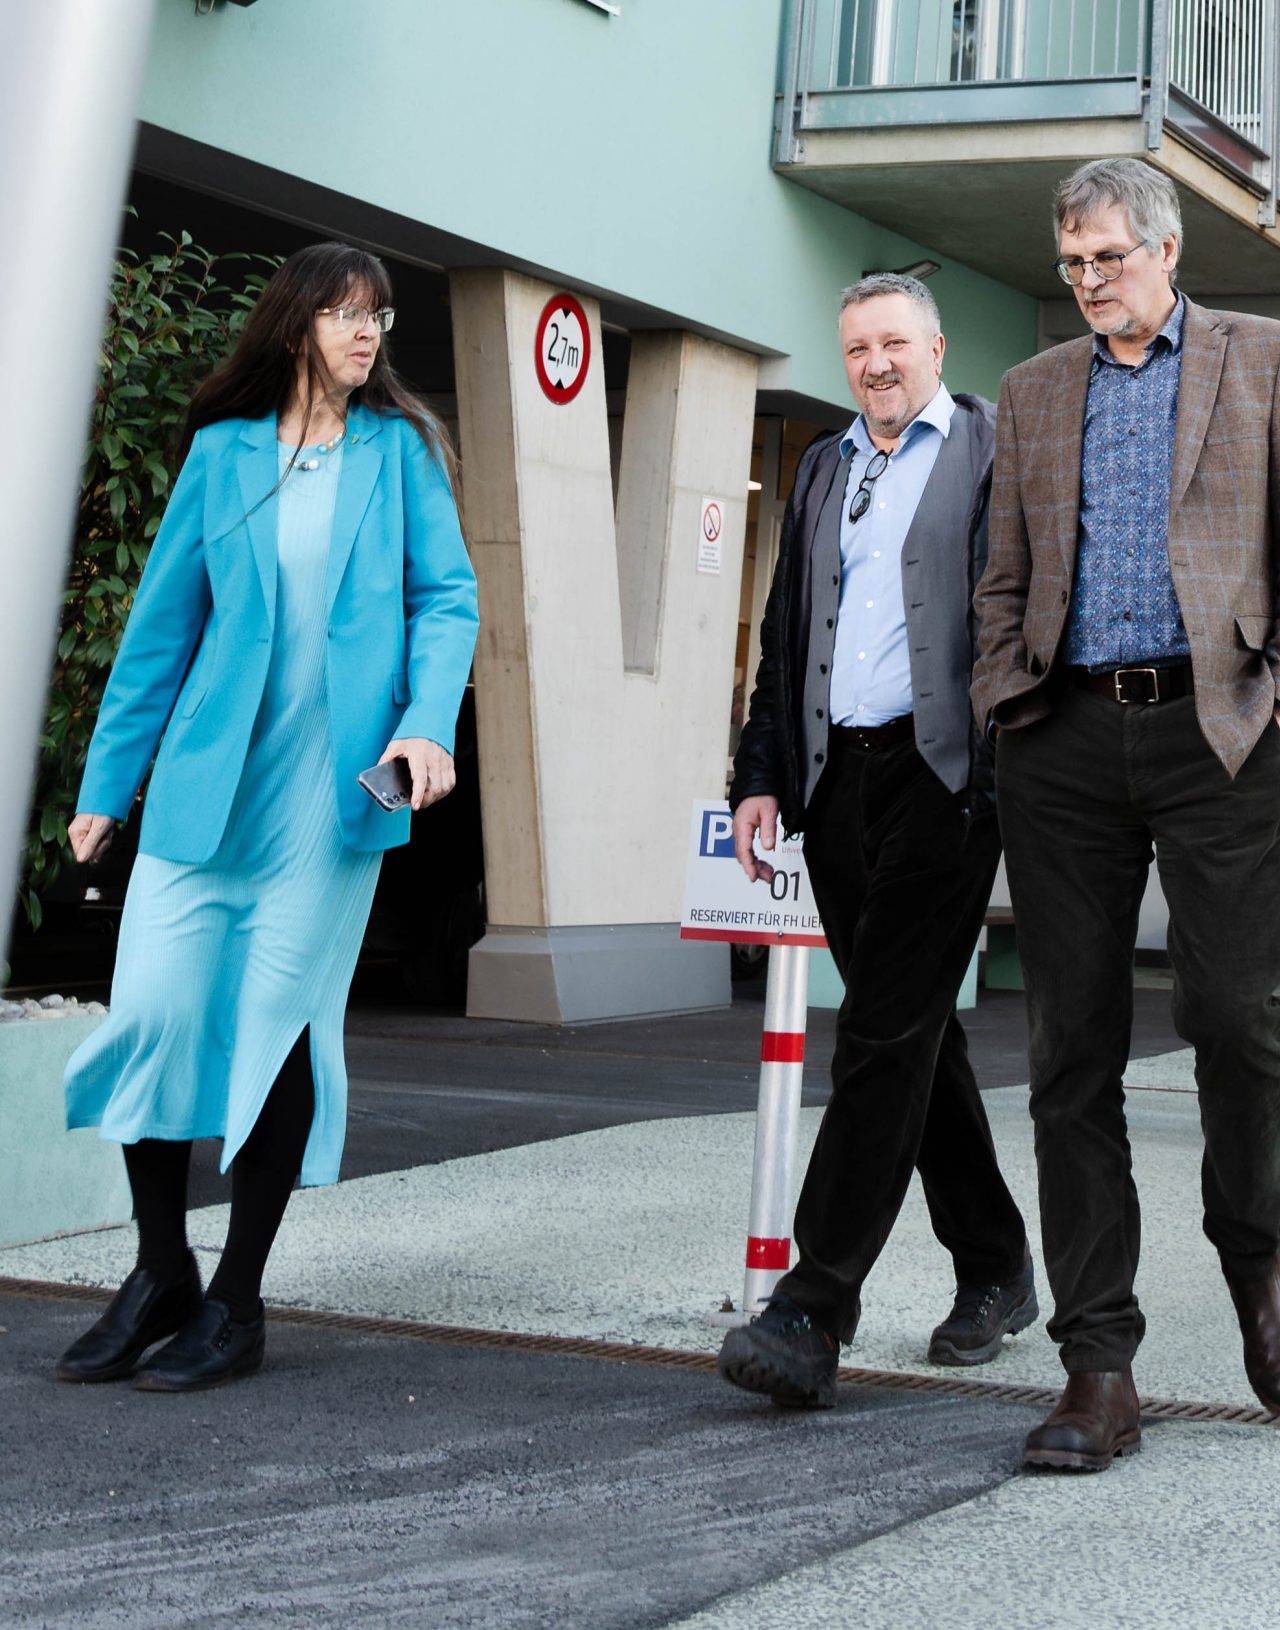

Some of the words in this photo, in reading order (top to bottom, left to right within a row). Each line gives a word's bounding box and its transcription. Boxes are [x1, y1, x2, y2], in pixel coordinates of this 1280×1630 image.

[547, 322, 579, 369] 2,7m
[770, 870, 801, 901] 01
[690, 908, 755, 926] RESERVIERT
[757, 910, 781, 926] FÜR
[783, 914, 798, 928] FH
